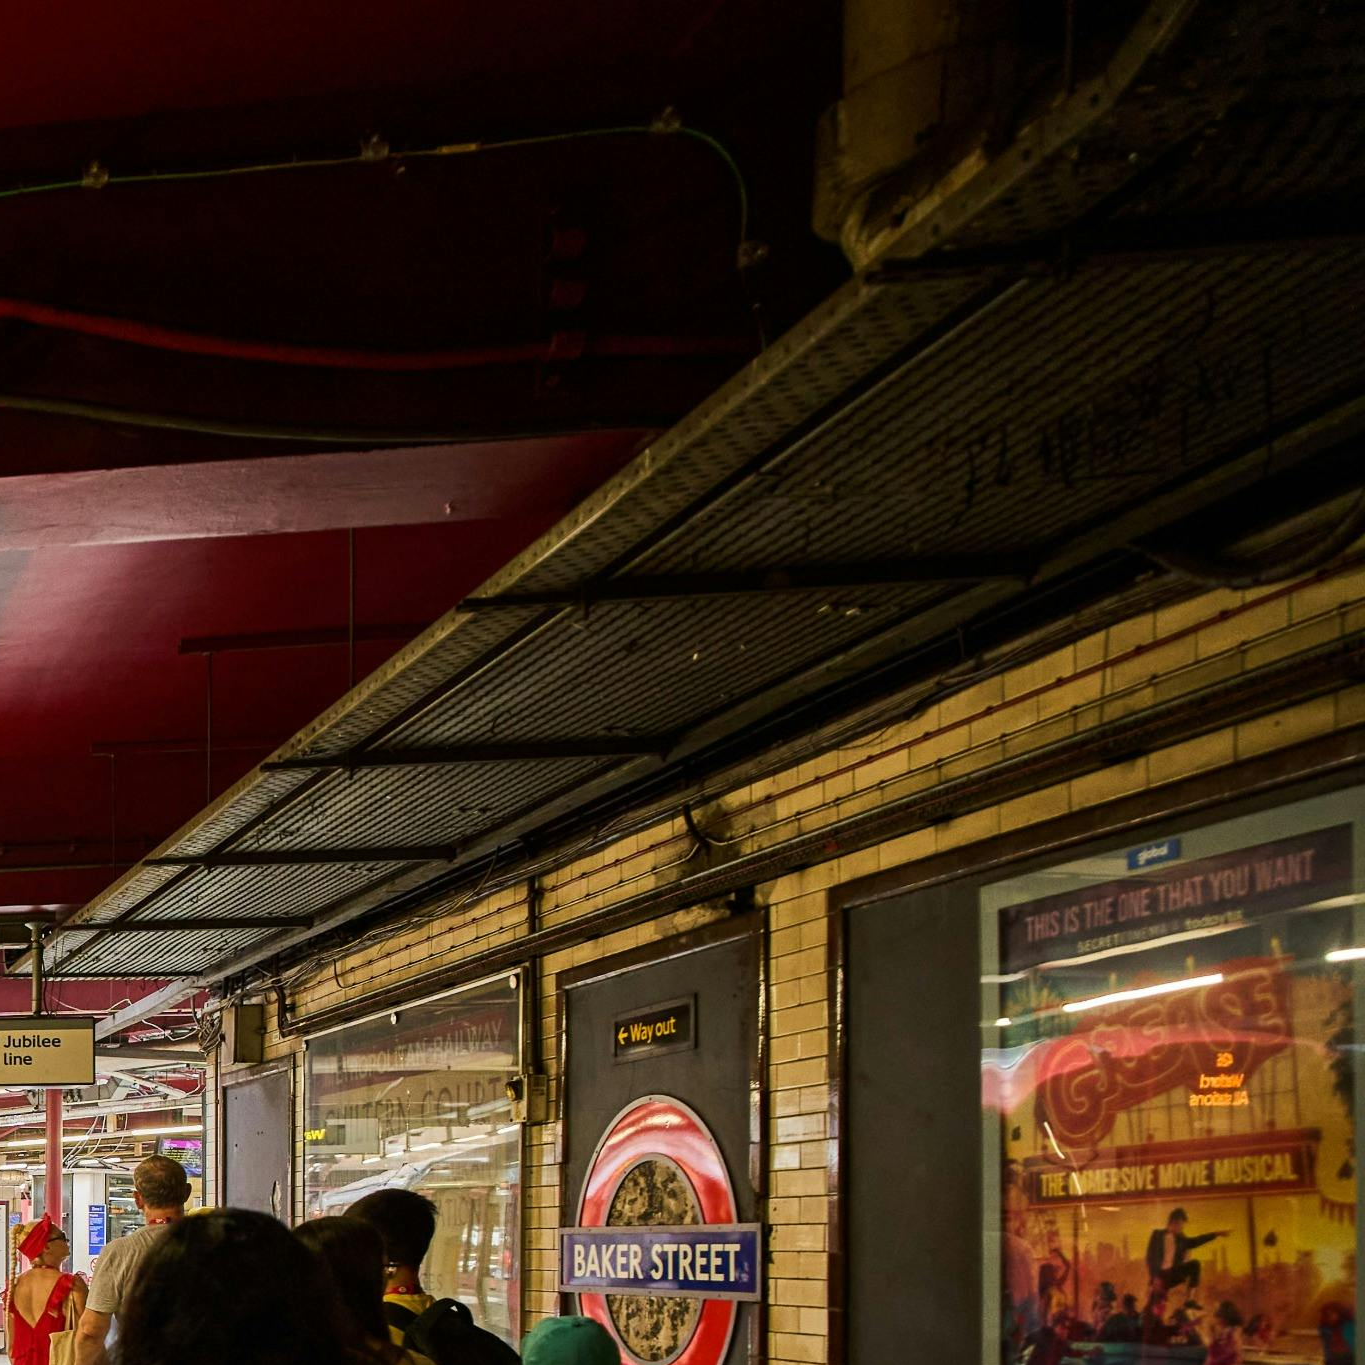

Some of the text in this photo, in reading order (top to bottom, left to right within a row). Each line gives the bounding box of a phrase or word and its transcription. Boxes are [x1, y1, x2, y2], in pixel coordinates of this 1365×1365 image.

[1136, 844, 1169, 865] global
[1024, 848, 1316, 942] THIS IS THE ONE THAT YOU WANT
[3, 1034, 62, 1049] Jubilee
[629, 1015, 676, 1044] Way out
[3, 1052, 33, 1066] line
[1039, 1152, 1298, 1197] THE IMMERSIVE MOVIE MUSICAL
[573, 1243, 742, 1282] BAKER STREET
